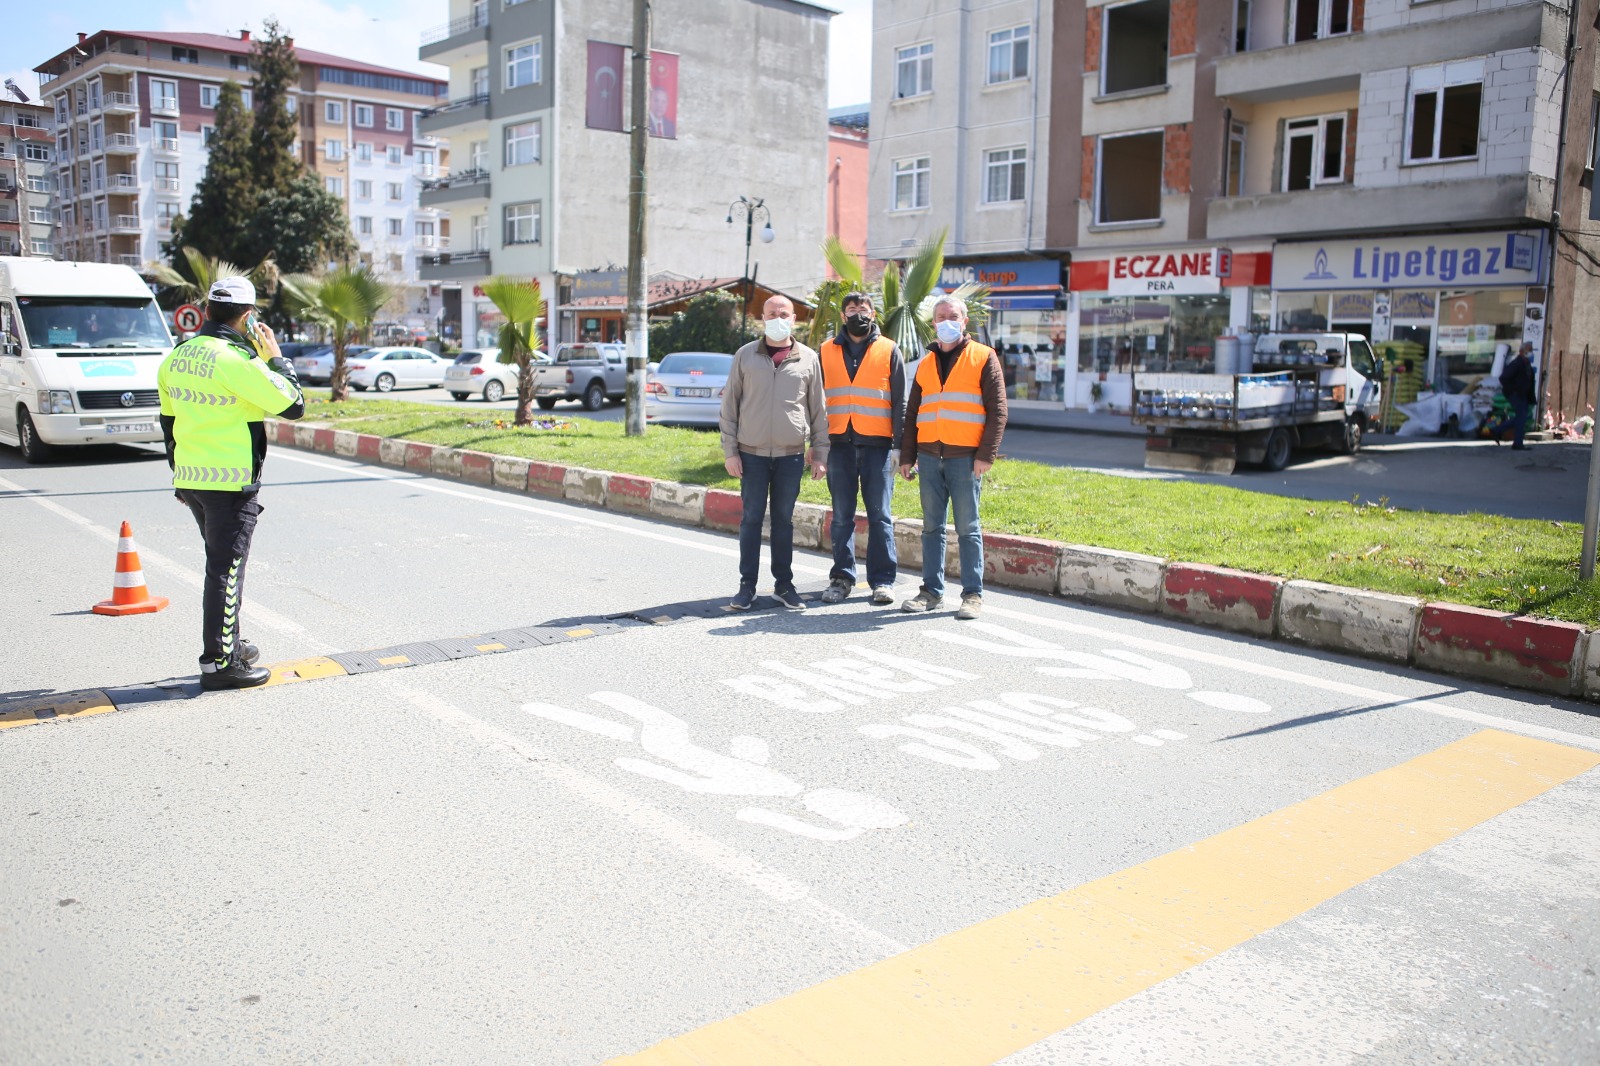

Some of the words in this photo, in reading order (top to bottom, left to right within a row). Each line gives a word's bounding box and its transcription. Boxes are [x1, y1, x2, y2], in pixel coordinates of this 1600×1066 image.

[1114, 253, 1212, 279] ECZANE
[1220, 254, 1229, 273] E
[1353, 245, 1501, 283] Lipetgaz
[941, 266, 975, 284] MNG
[978, 269, 1017, 285] kargo
[1147, 281, 1175, 290] PERA
